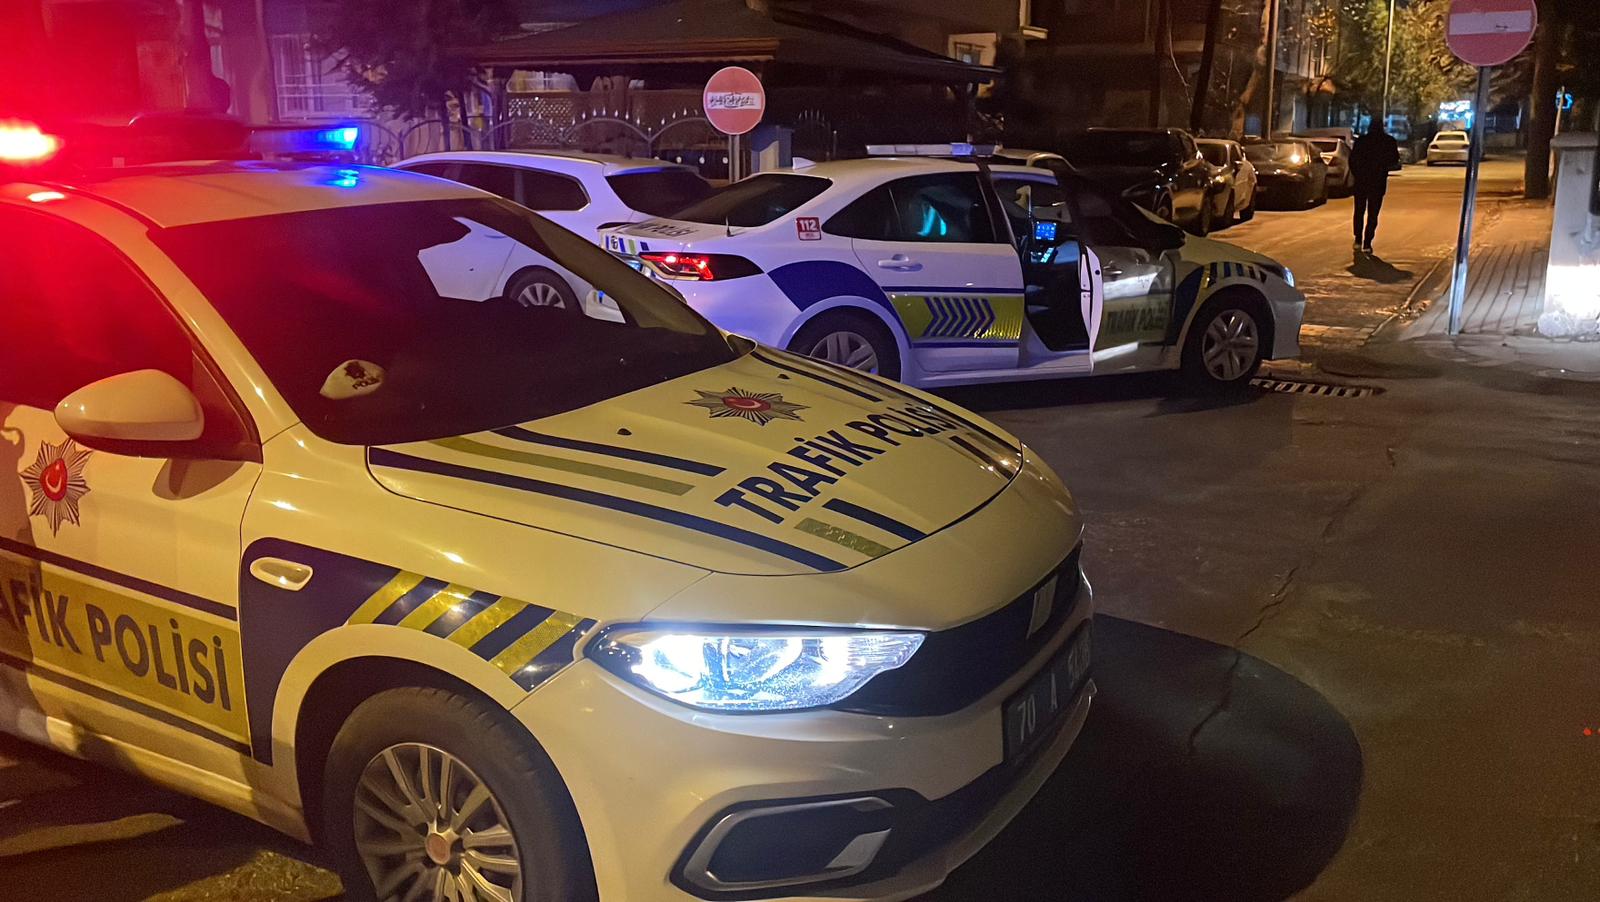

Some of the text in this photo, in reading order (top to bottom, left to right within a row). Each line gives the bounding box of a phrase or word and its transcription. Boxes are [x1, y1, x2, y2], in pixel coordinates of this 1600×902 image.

[799, 219, 818, 231] 112
[714, 430, 887, 524] TRAFİK
[85, 604, 231, 711] POLİSİ
[1017, 694, 1036, 744] 70
